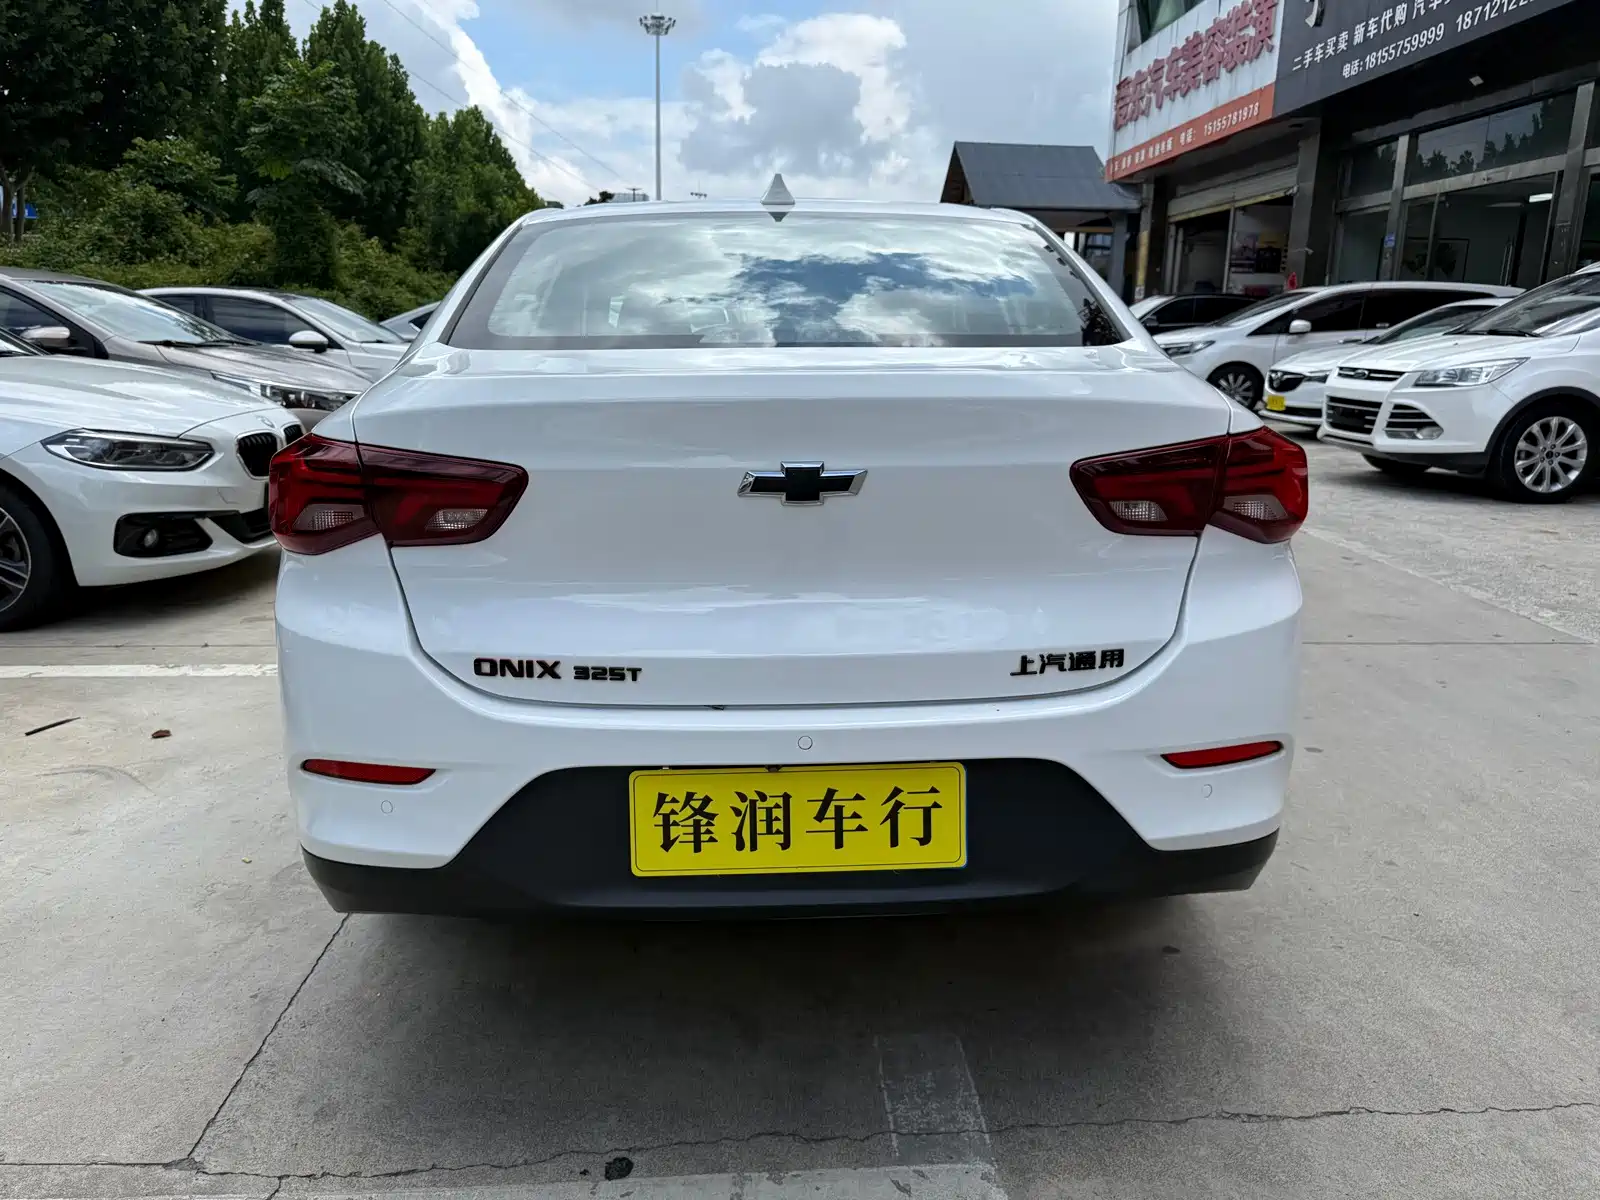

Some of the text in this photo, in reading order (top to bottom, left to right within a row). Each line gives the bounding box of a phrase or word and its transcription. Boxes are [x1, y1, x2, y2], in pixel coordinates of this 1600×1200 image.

[1456, 0, 1534, 33] 1871212
[1292, 31, 1349, 71] 二手车买卖
[1353, 3, 1407, 46] 新车代购
[1203, 102, 1260, 137] 15155781978
[473, 657, 642, 682] ONIX 325T
[1009, 648, 1125, 676] 上汽通用
[652, 785, 943, 854] 锋润车行
